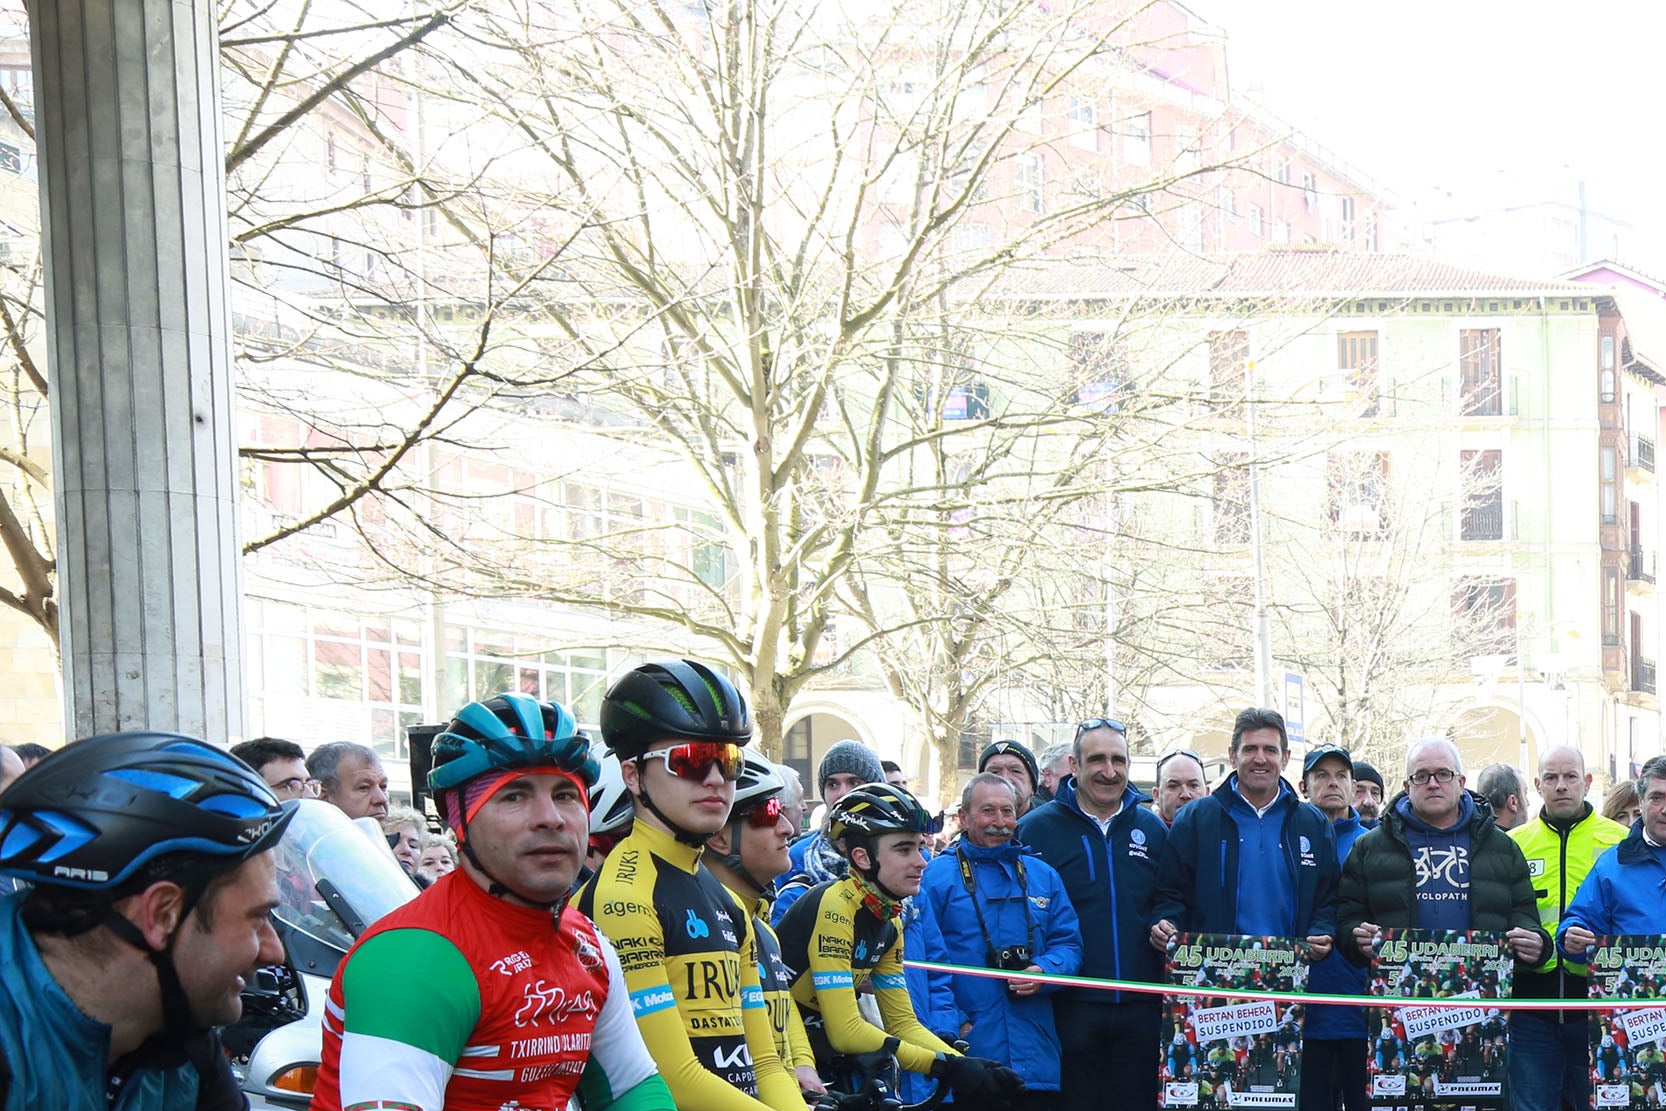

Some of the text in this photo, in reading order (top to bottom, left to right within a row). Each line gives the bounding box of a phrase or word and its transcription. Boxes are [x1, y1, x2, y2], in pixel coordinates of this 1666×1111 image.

[838, 812, 871, 831] Spiuk
[1416, 892, 1468, 900] YCLOPATH
[1174, 945, 1294, 967] 45 UDABERRI
[1379, 940, 1498, 962] 45 UDABERRI
[1594, 947, 1623, 968] 45
[1388, 971, 1399, 986] 5
[1605, 977, 1616, 992] 5
[1198, 1006, 1272, 1024] BERTAN BEHERA
[1405, 1006, 1441, 1022] BERTAN
[1409, 1008, 1481, 1034] SUSPENDIDO
[1627, 1012, 1662, 1028] BERTAN
[1199, 1018, 1273, 1036] SUSPENDIDO
[1244, 1096, 1293, 1104] PNEUMAX
